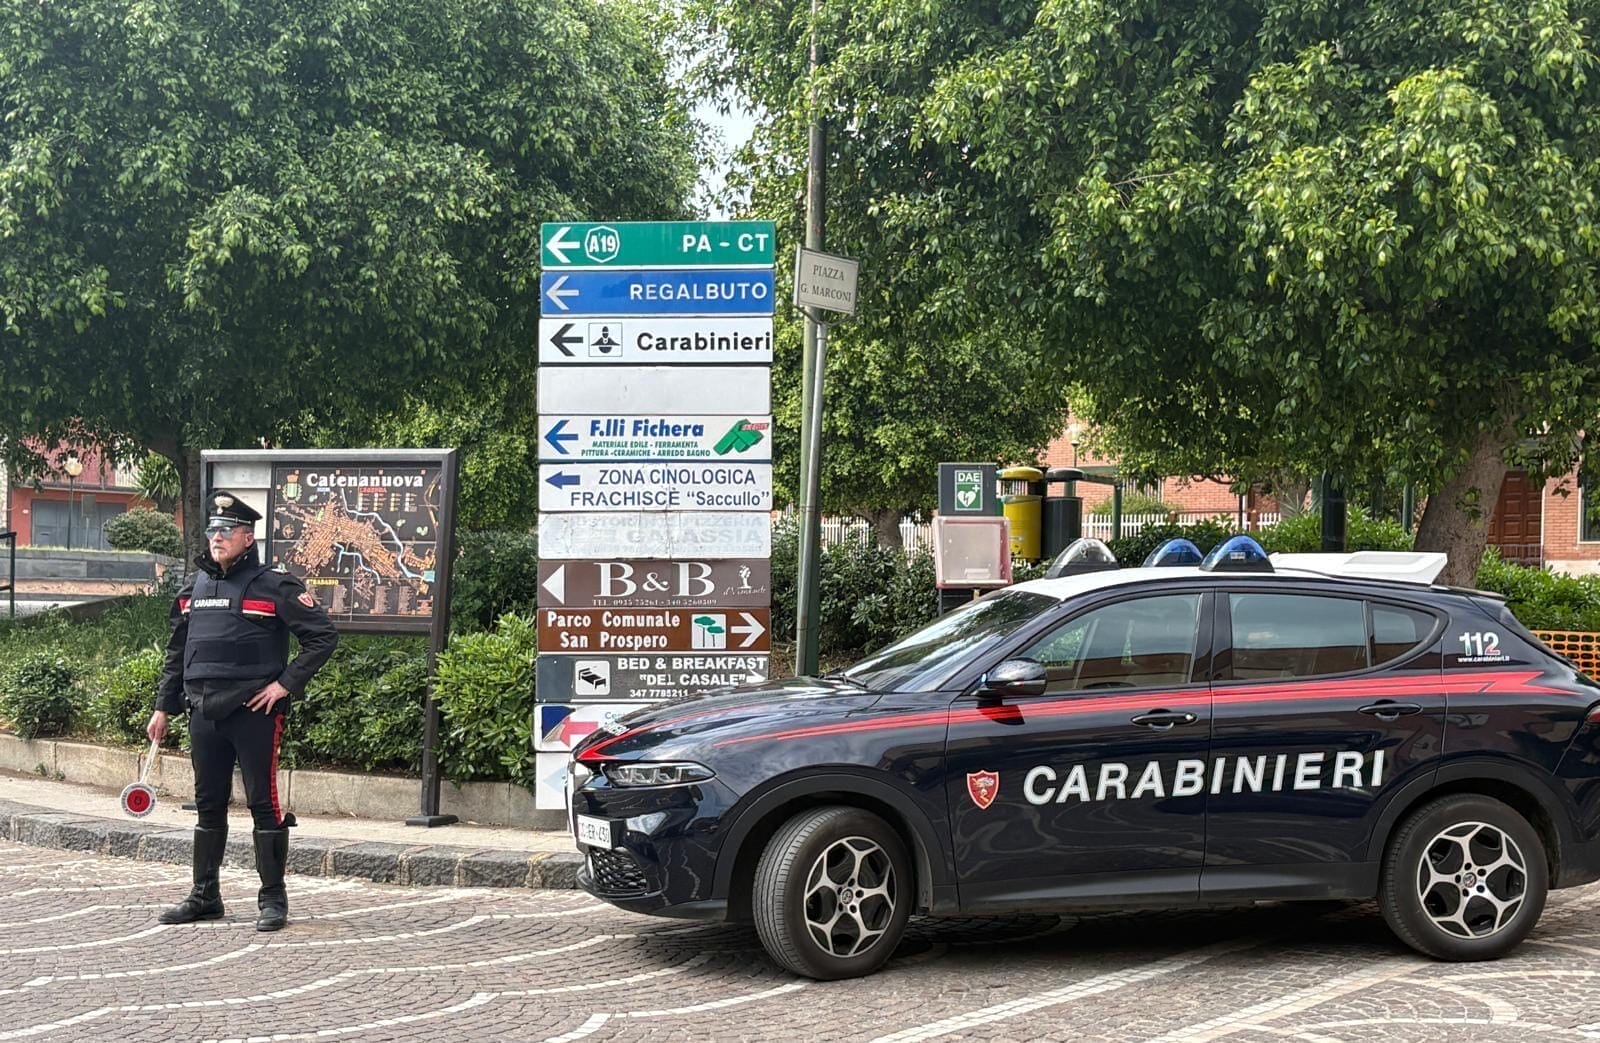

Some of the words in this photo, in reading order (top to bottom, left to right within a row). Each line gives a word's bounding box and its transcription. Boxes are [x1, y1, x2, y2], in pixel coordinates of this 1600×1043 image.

[588, 234, 616, 252] A19
[682, 234, 711, 252] PA
[738, 233, 769, 251] CT
[813, 264, 845, 281] PIAZZA
[630, 282, 768, 300] REGALBUTO
[800, 283, 809, 294] G.
[812, 285, 852, 302] MARCONI
[636, 331, 771, 351] Carabinieri
[590, 418, 626, 437] F.lli
[632, 418, 705, 437] Fichera
[581, 449, 609, 457] PITTURA
[657, 449, 685, 457] ARREDO
[687, 449, 711, 457] BAGNO
[592, 440, 628, 449] MATERIALE
[630, 440, 649, 449] EDILE
[655, 440, 698, 449] FERRAMENTA
[306, 473, 424, 487] Catenanuova
[598, 469, 645, 485] ZONA
[650, 469, 756, 485] CINOLOGICA
[957, 472, 980, 482] DAE
[194, 598, 230, 608] CARABINIERI
[547, 610, 592, 628] Parco
[602, 610, 681, 628] Comunale
[560, 631, 588, 648] San
[600, 631, 668, 651] Prospero
[1459, 631, 1501, 656] 112
[617, 657, 650, 670] BED
[655, 657, 666, 670] &
[672, 656, 767, 670] BREAKFAST
[629, 689, 647, 698] 347
[1023, 749, 1386, 806] CARABINIERI
